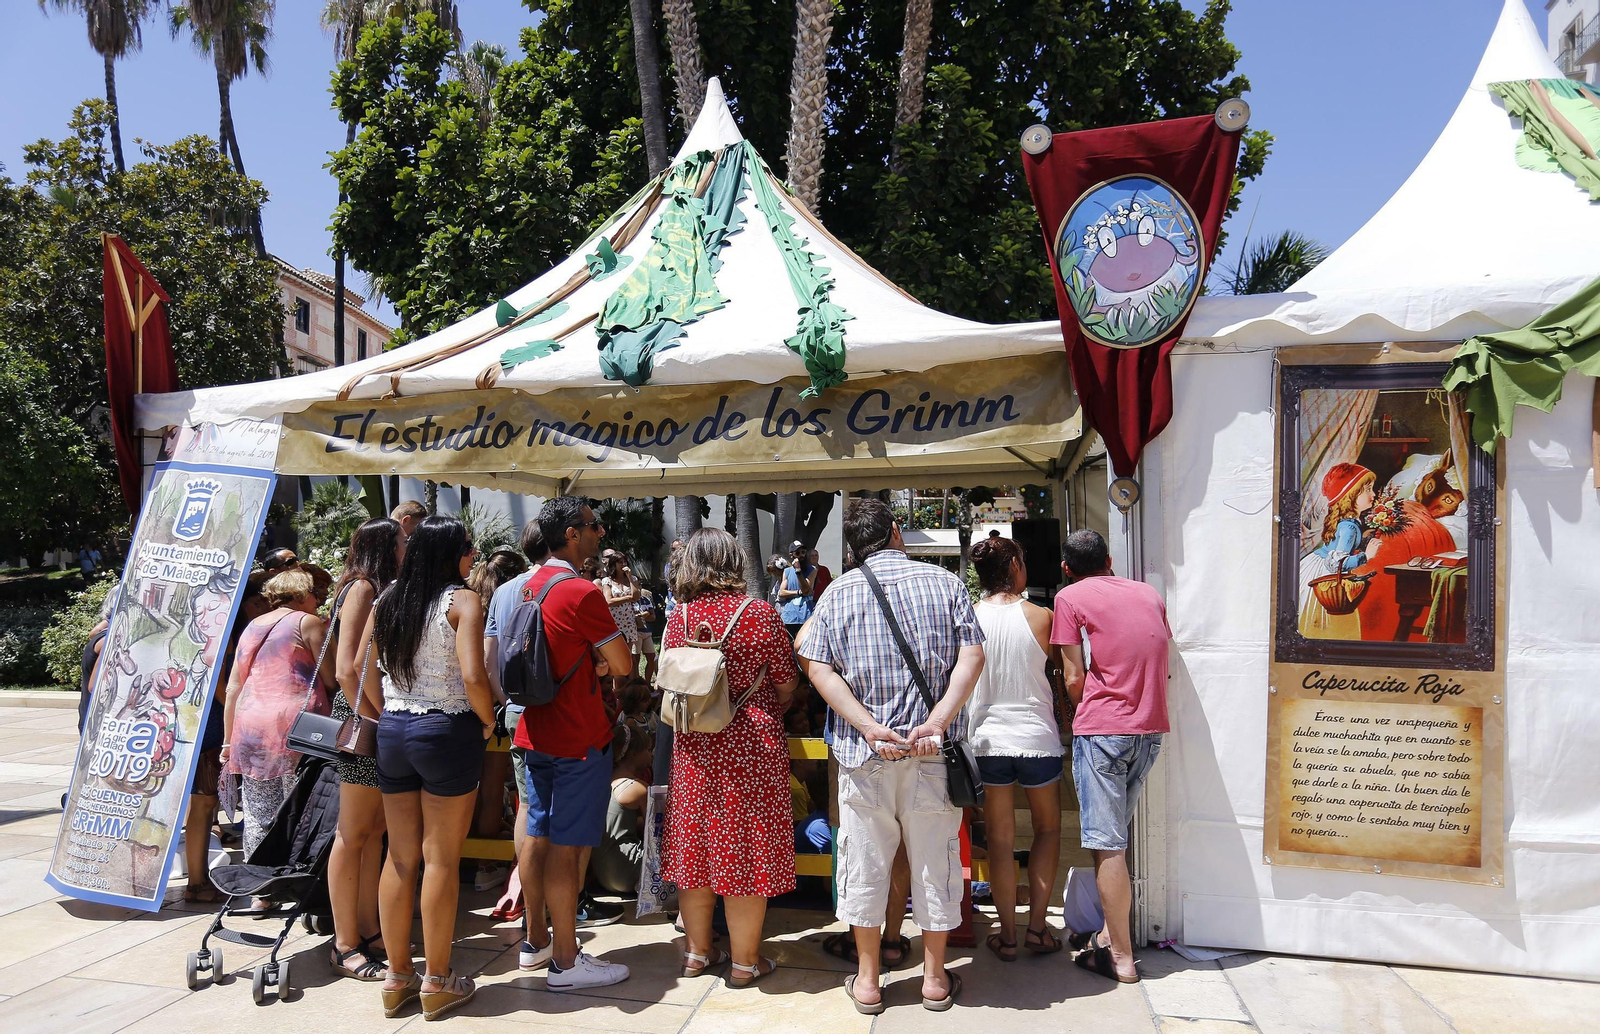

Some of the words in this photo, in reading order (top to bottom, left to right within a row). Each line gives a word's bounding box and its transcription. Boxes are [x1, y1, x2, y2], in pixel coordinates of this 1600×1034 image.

[325, 408, 376, 453] El
[380, 405, 523, 453] estudio
[526, 410, 688, 463] mágico
[691, 395, 749, 445] de
[760, 387, 831, 438] los
[846, 389, 1020, 435] Grimm
[142, 543, 226, 564] Ayuntamiento
[143, 562, 158, 575] de
[161, 564, 208, 584] Málaga
[1302, 670, 1410, 697] Caperucita
[1414, 674, 1465, 704] Roja
[1314, 709, 1345, 723] Érase
[1350, 717, 1369, 725] una
[1375, 717, 1390, 726] vez
[1463, 722, 1471, 732] y
[1293, 727, 1320, 738] dulce
[1322, 729, 1382, 742] muchachita
[1384, 735, 1402, 746] que
[1420, 735, 1457, 746] cuanto
[1458, 739, 1471, 747] se
[90, 748, 149, 779] 2019
[1292, 742, 1303, 753] la
[1304, 746, 1325, 754] veía
[1327, 748, 1339, 756] se
[1340, 746, 1351, 757] la
[1352, 747, 1390, 760] amaba,
[1391, 752, 1415, 763] pero
[1417, 751, 1446, 762] sobre
[1447, 752, 1472, 764] todo
[1292, 760, 1302, 769] la
[1306, 762, 1338, 775] quería
[1343, 765, 1355, 773] su
[1360, 764, 1396, 776] abuela,
[1401, 769, 1420, 779] que
[1424, 770, 1439, 778] no
[1442, 769, 1471, 780] sabía
[91, 788, 142, 806] CUENTOS
[1292, 778, 1310, 788] que
[1312, 776, 1339, 788] darle
[1351, 779, 1362, 790] la
[1364, 782, 1391, 792] niña.
[1394, 783, 1410, 794] Un
[1413, 784, 1439, 796] buen
[1441, 785, 1458, 797] día
[1461, 787, 1471, 798] le
[92, 803, 136, 817] HERMANOS
[1291, 793, 1324, 805] regaló
[1326, 797, 1346, 805] una
[1349, 797, 1402, 810] caperucita
[1404, 800, 1418, 811] de
[1420, 802, 1472, 816] terciopelo
[1291, 810, 1313, 821] rojo,
[1315, 814, 1323, 822] y
[1326, 813, 1354, 823] como
[1356, 813, 1367, 824] le
[1368, 815, 1410, 828] sentaba
[1412, 821, 1436, 832] muy
[1438, 820, 1461, 831] bien
[1463, 824, 1471, 834] y
[1291, 827, 1306, 835] no
[1306, 826, 1349, 840] quería...
